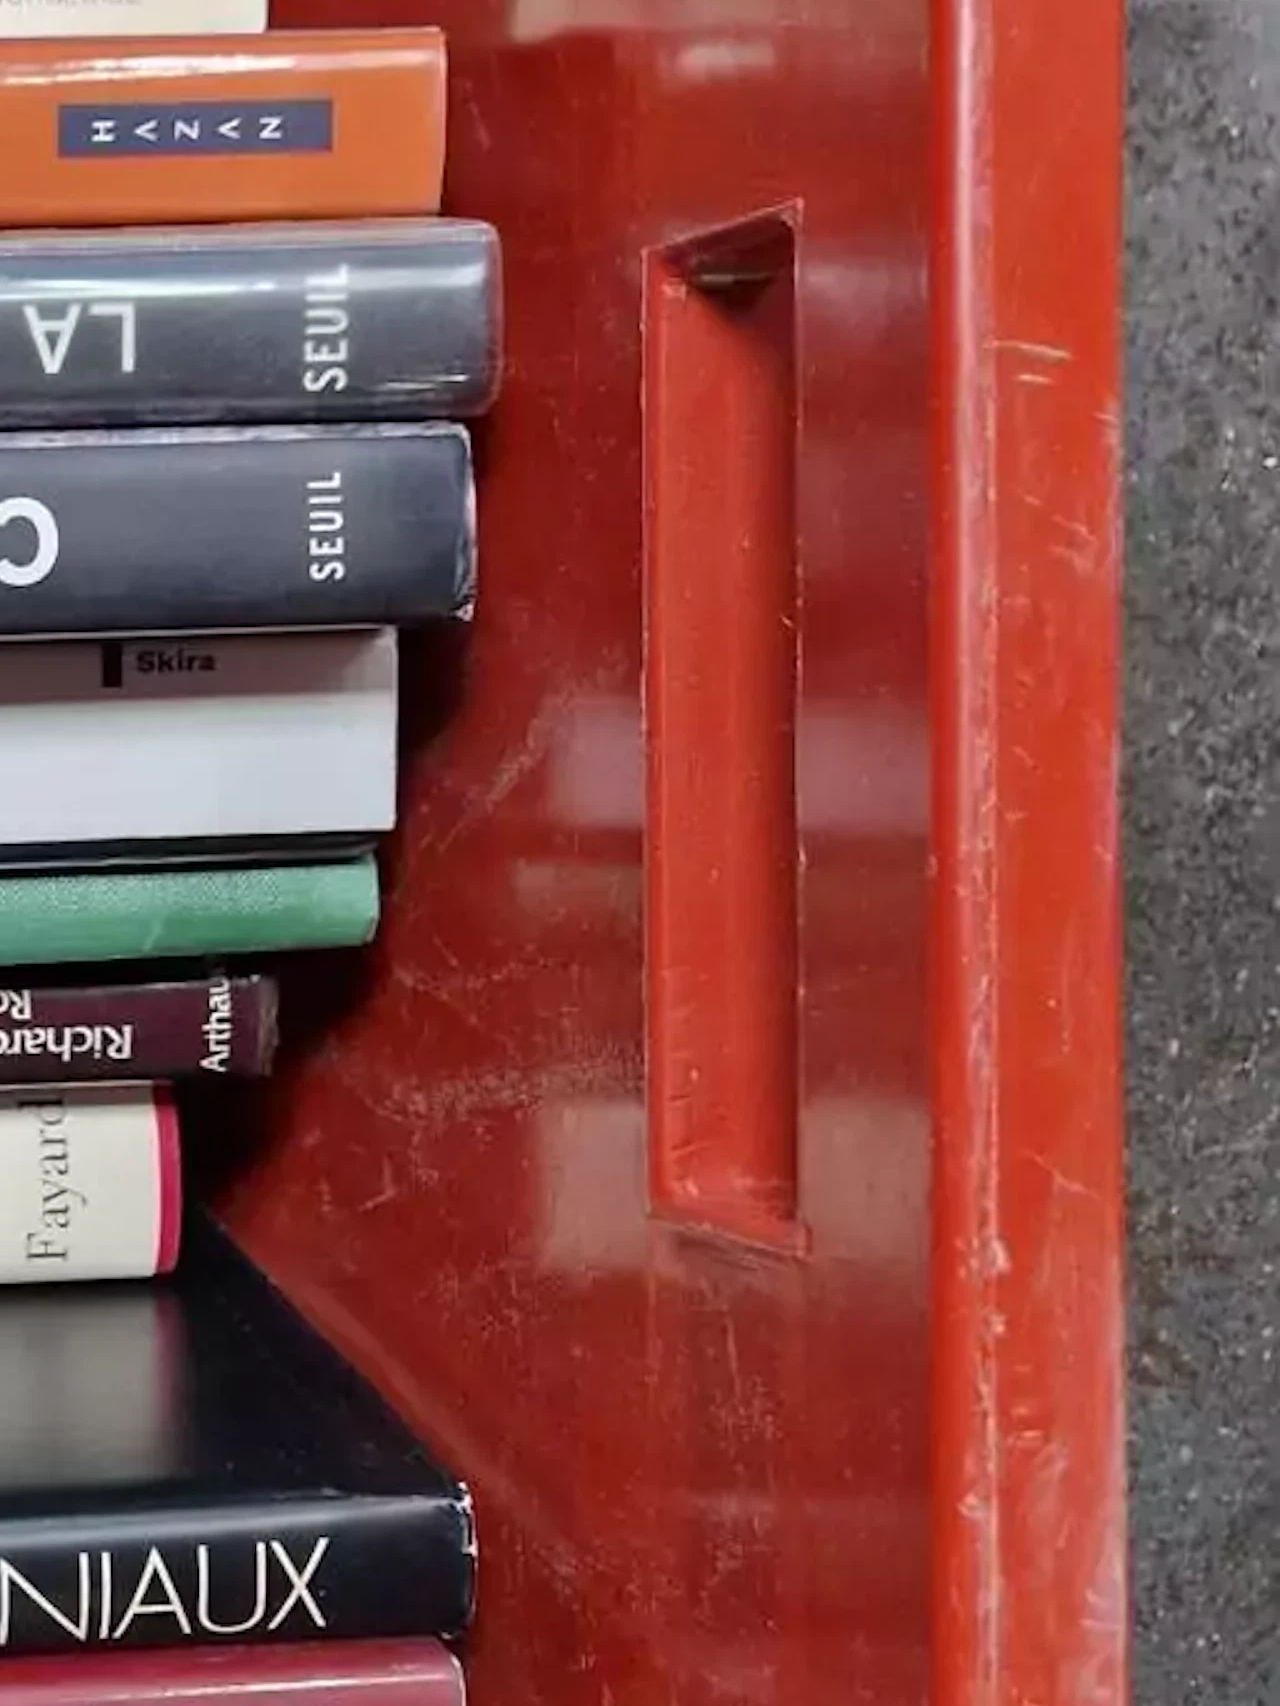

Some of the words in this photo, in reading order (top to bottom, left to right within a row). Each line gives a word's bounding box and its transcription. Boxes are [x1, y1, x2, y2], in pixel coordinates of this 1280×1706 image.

[25, 300, 137, 378] LA
[304, 263, 349, 393] SEUIL
[308, 472, 343, 584] SEUIL
[137, 649, 215, 675] Skira
[199, 967, 233, 1072] Arthau
[17, 1096, 87, 1261] Fayard
